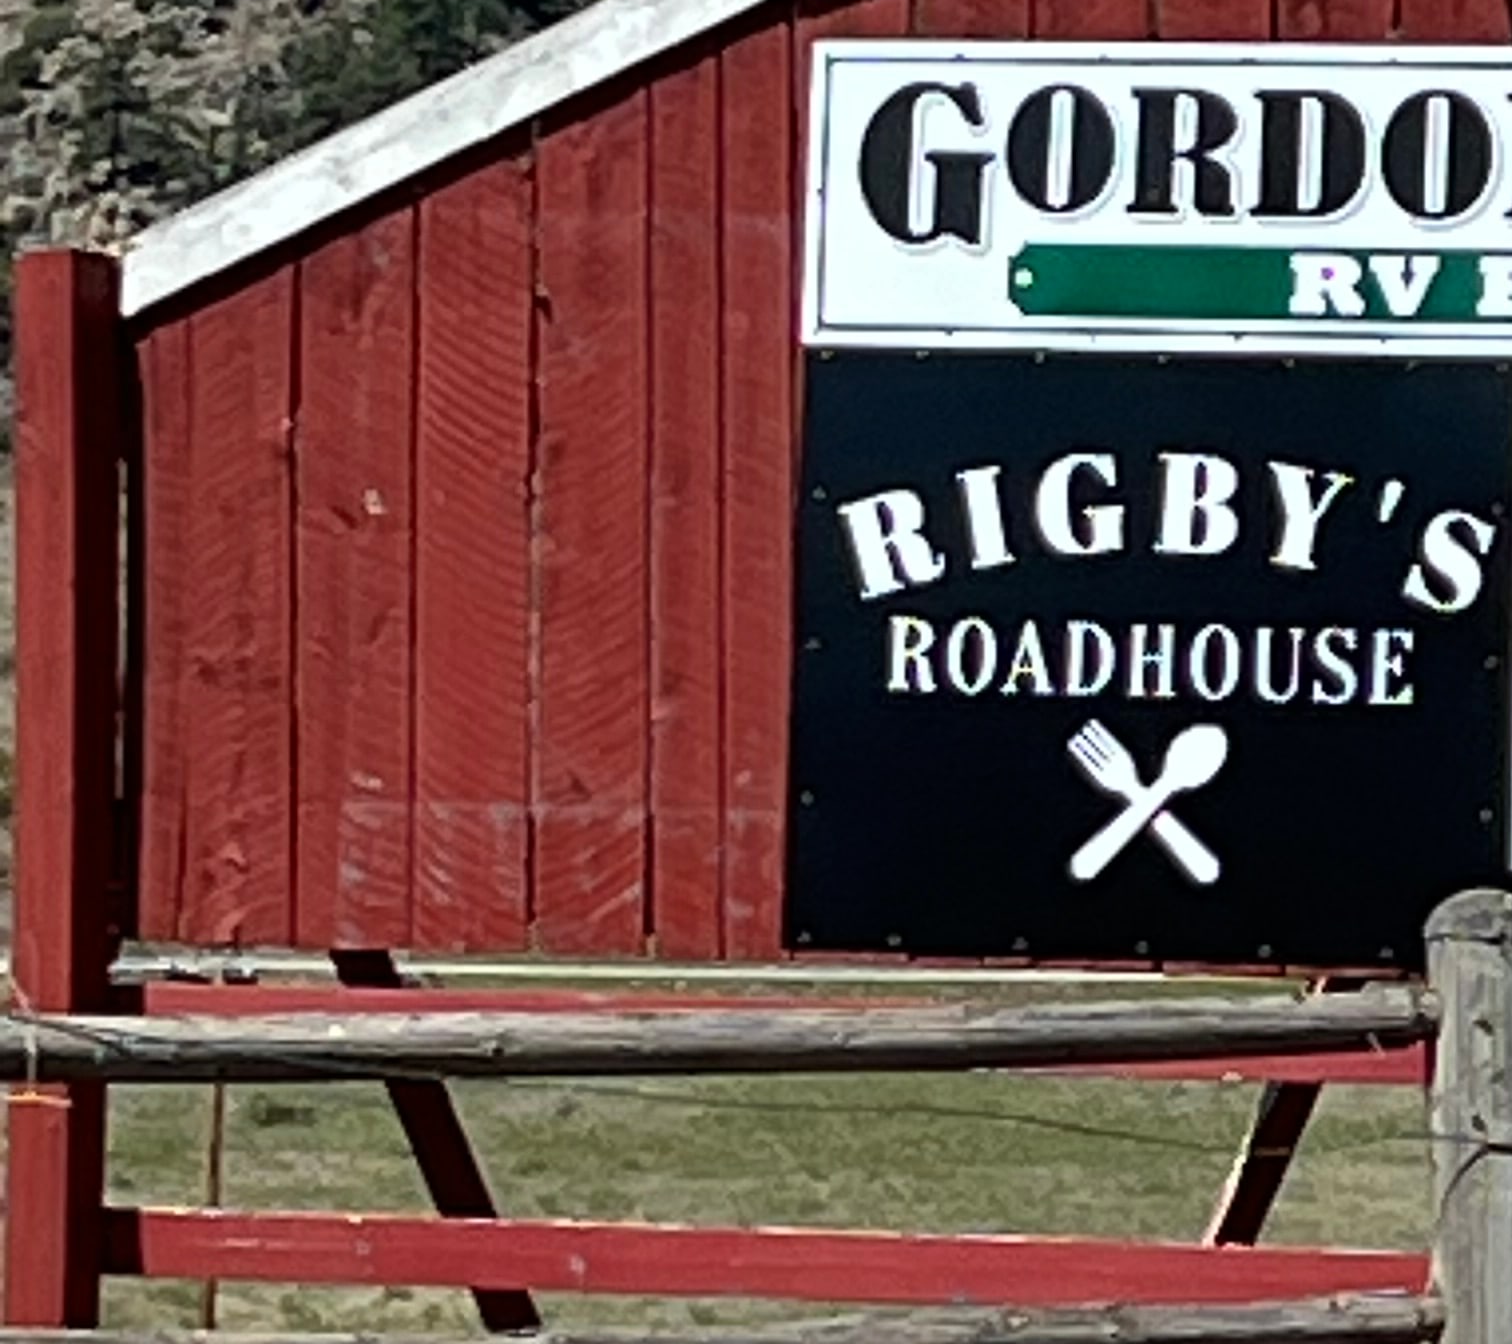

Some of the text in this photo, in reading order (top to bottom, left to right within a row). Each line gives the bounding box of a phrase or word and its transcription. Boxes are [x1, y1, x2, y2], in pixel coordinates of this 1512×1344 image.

[1288, 253, 1440, 317] RV
[837, 453, 1496, 613] RIGBY'S
[886, 616, 1415, 704] ROADHOUSE
